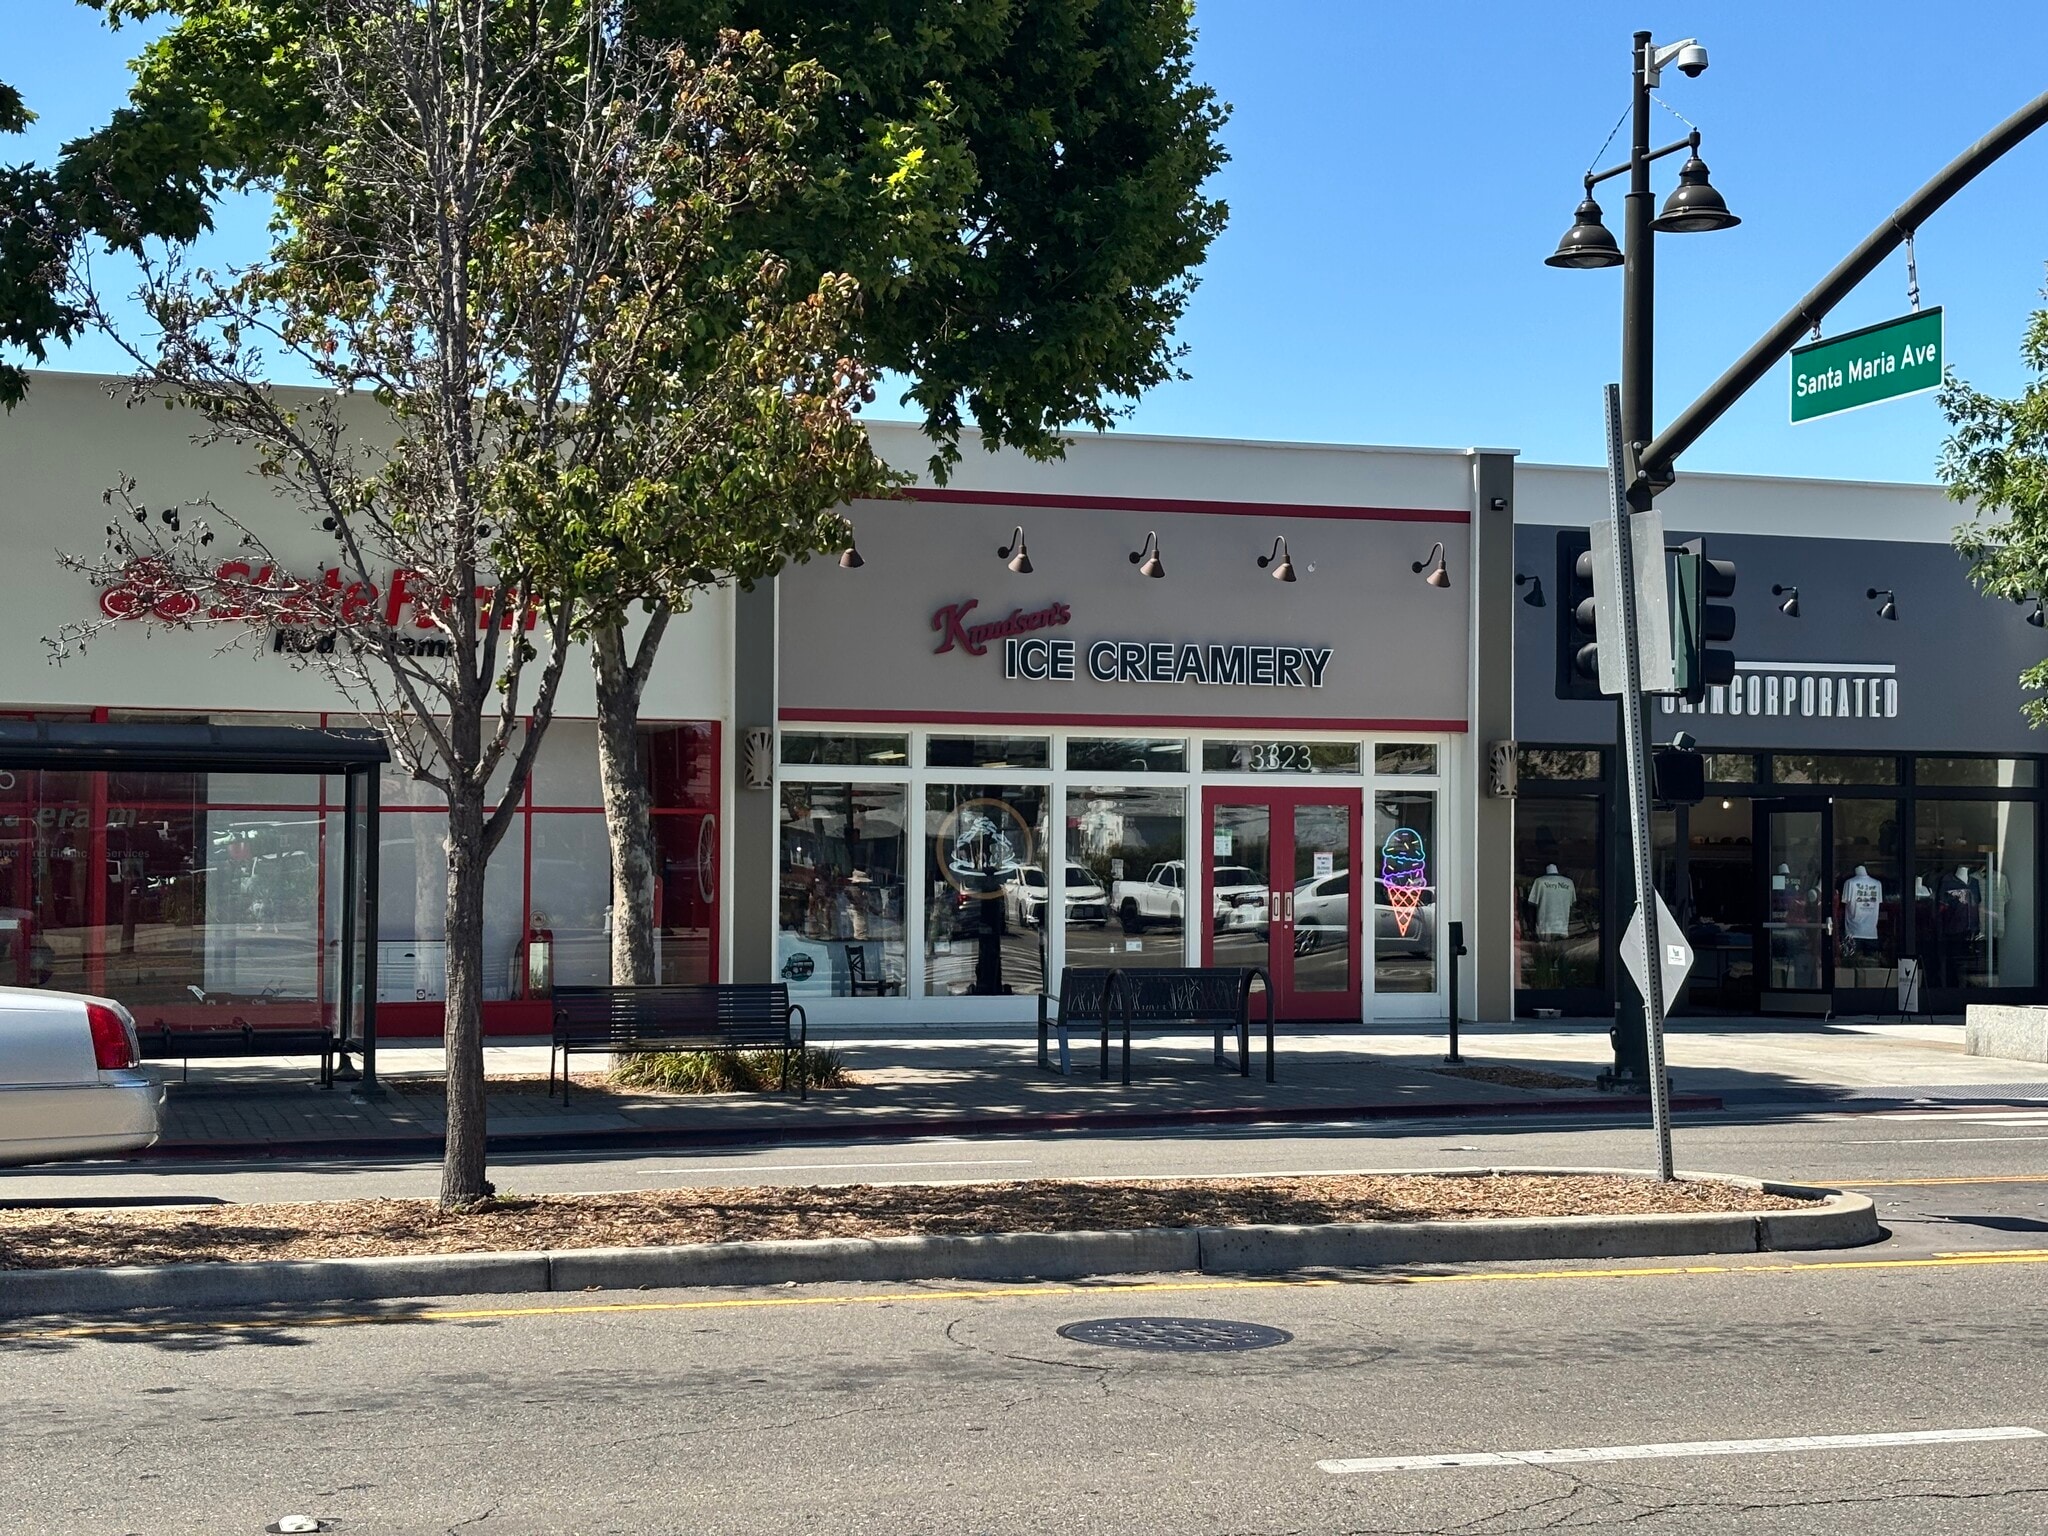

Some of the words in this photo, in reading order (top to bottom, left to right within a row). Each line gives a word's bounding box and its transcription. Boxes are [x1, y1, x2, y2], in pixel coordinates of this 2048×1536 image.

[1796, 366, 1842, 397] Santa
[1848, 351, 1895, 384] Maria
[1900, 343, 1936, 370] Ave
[931, 599, 1072, 656] Knudsen's
[1005, 638, 1075, 681] ICE
[1088, 640, 1334, 688] CREAMERY
[1661, 674, 1898, 718] NCORPORATED
[1250, 744, 1312, 771] 3323
[1544, 881, 1557, 890] Very
